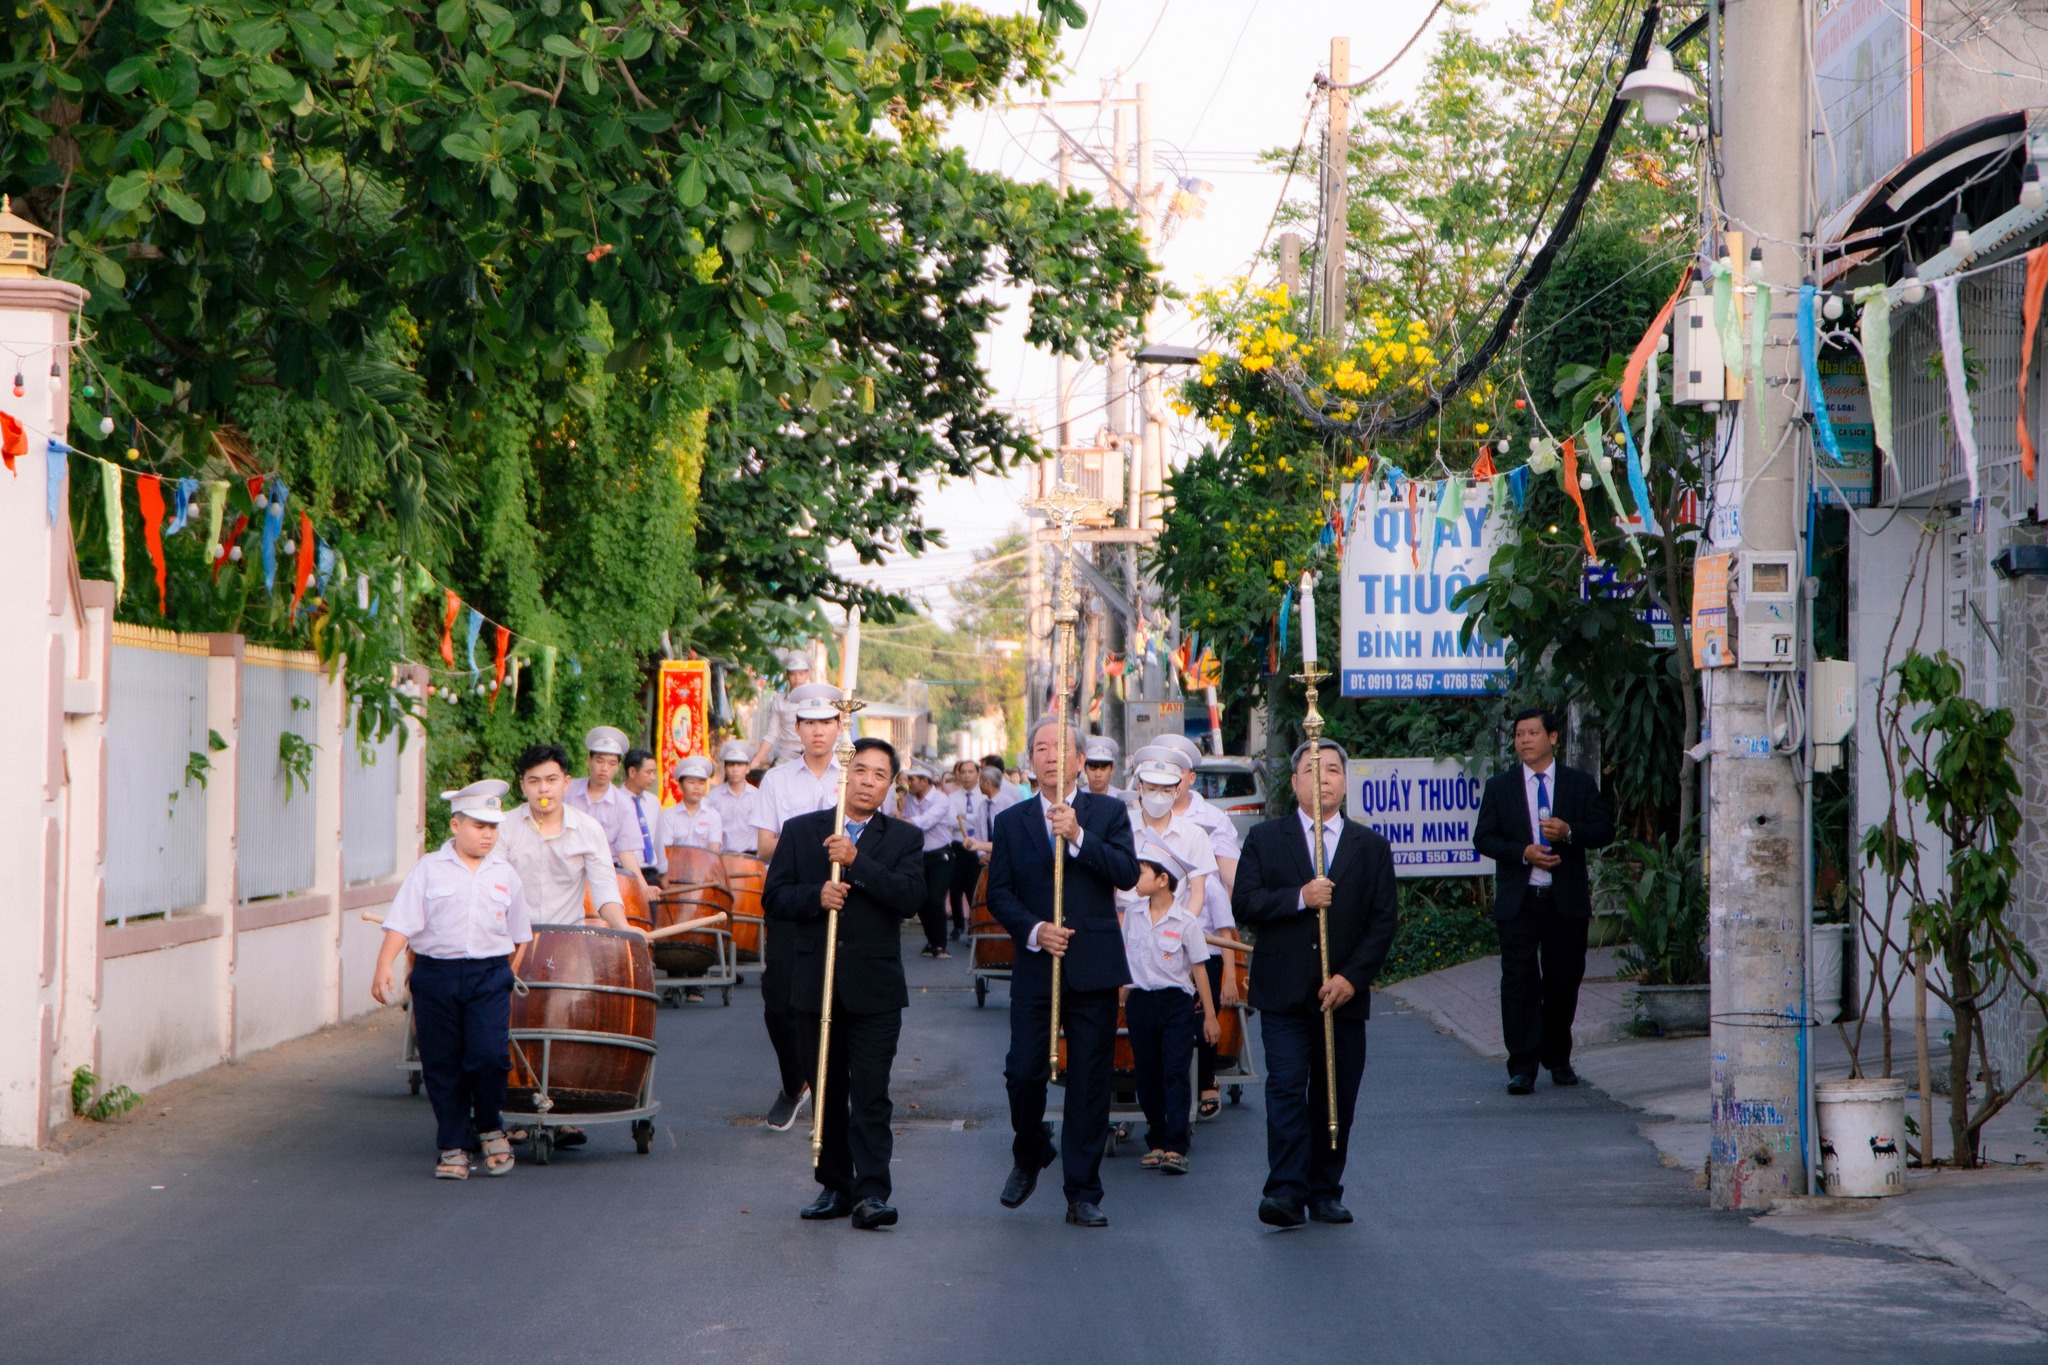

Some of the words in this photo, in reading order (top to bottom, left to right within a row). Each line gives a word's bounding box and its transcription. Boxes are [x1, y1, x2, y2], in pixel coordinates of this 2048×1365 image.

[1358, 624, 1422, 658] BÌNH
[1432, 630, 1503, 658] MINH
[1368, 673, 1393, 690] 0919
[1395, 673, 1413, 690] 125
[1415, 673, 1434, 690] 457
[1443, 673, 1468, 690] 0768
[1470, 673, 1488, 690] 550
[1362, 768, 1412, 816] QUẦY
[1422, 821, 1469, 843] MINH
[1394, 852, 1423, 864] 0768
[1426, 851, 1448, 863] 550
[1451, 850, 1474, 862] 785
